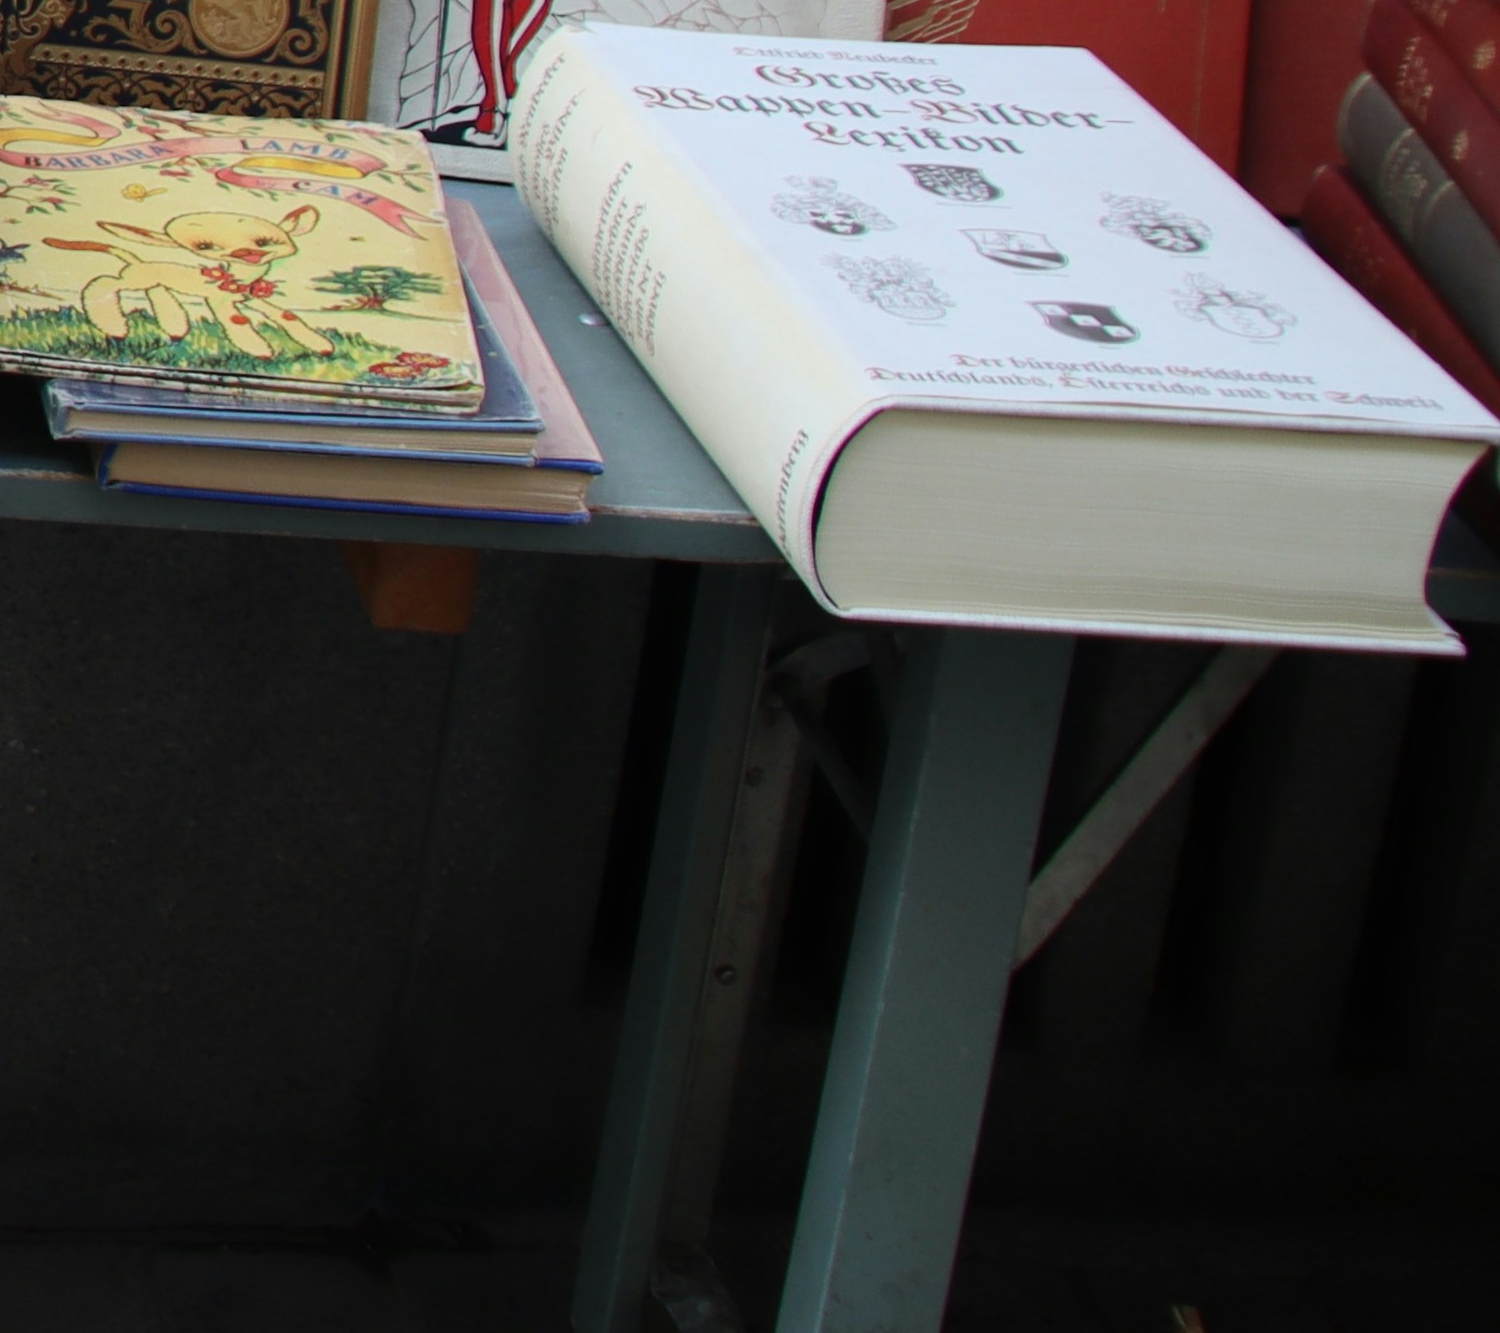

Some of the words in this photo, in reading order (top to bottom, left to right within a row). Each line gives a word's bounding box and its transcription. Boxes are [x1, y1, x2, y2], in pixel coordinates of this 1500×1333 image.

[754, 64, 966, 96] Großes
[803, 121, 1025, 154] Lexikon
[23, 141, 173, 170] BARBARA
[239, 138, 351, 161] LAMB
[291, 179, 379, 206] CAM
